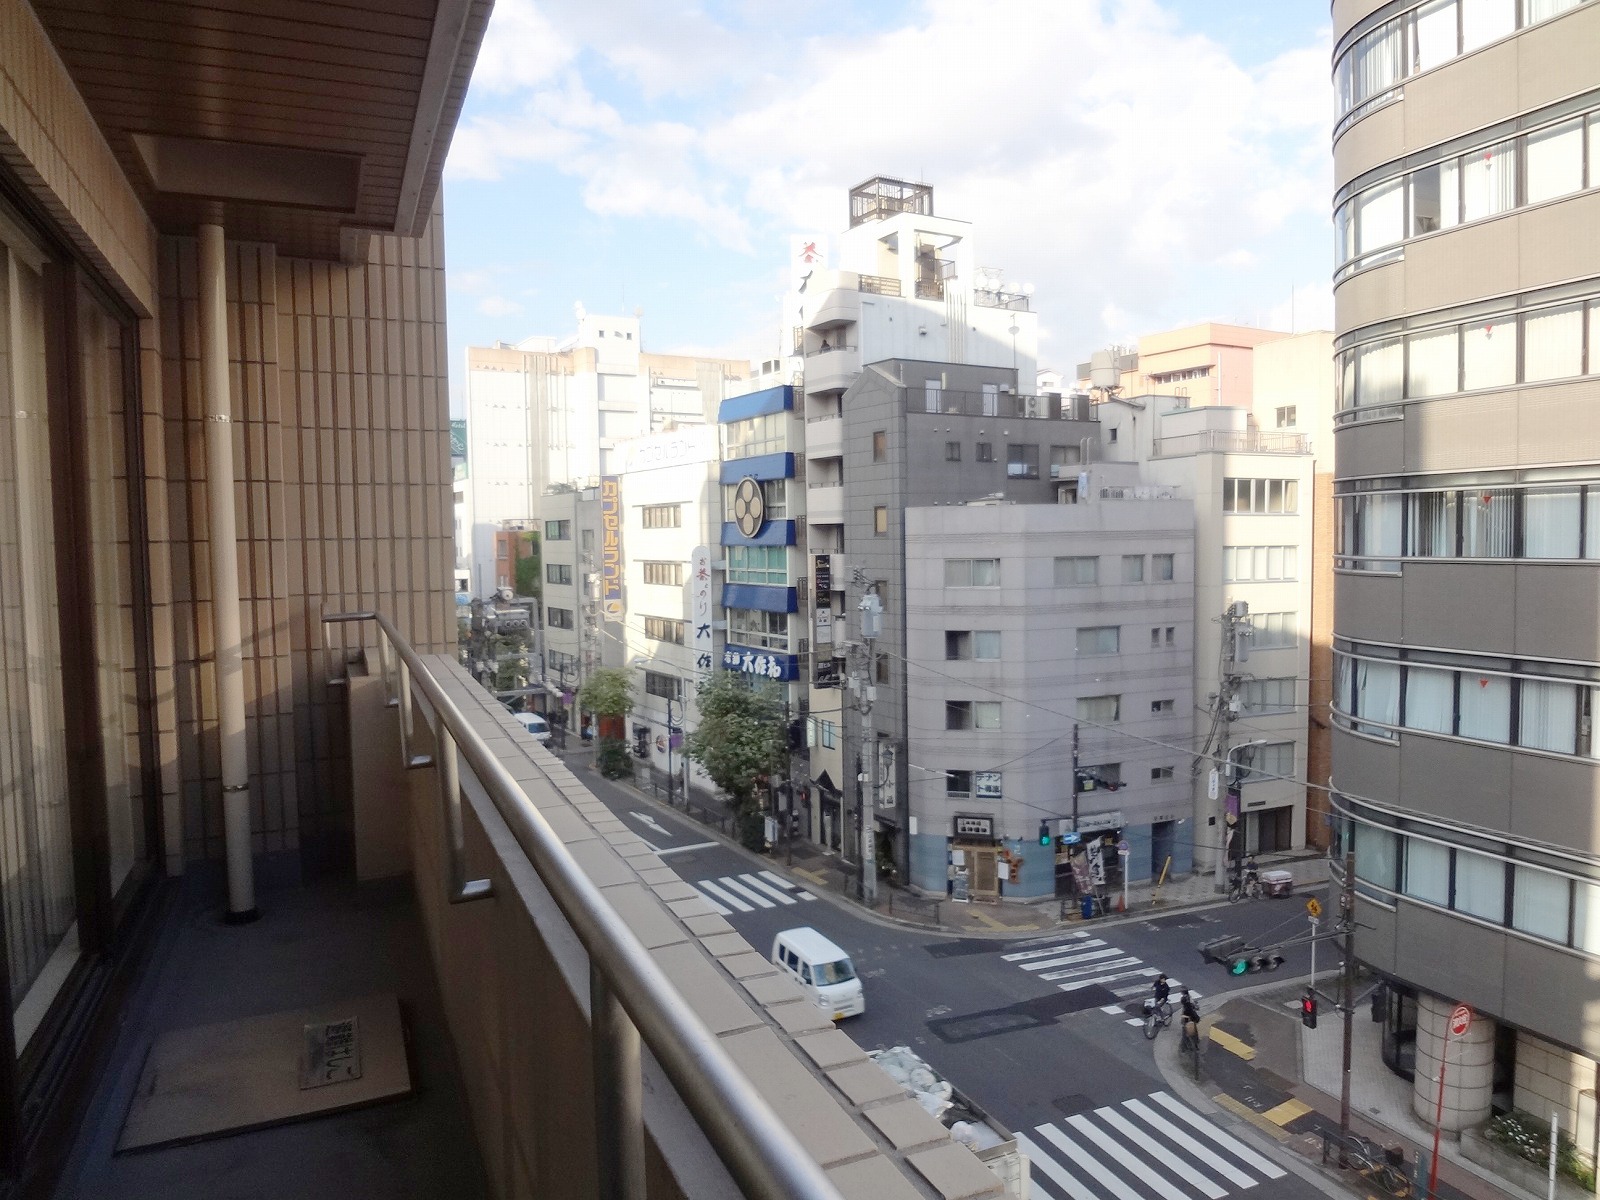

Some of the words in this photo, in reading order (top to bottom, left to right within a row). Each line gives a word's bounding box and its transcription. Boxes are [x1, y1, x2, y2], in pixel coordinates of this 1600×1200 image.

[602, 480, 620, 596] カプセルランド
